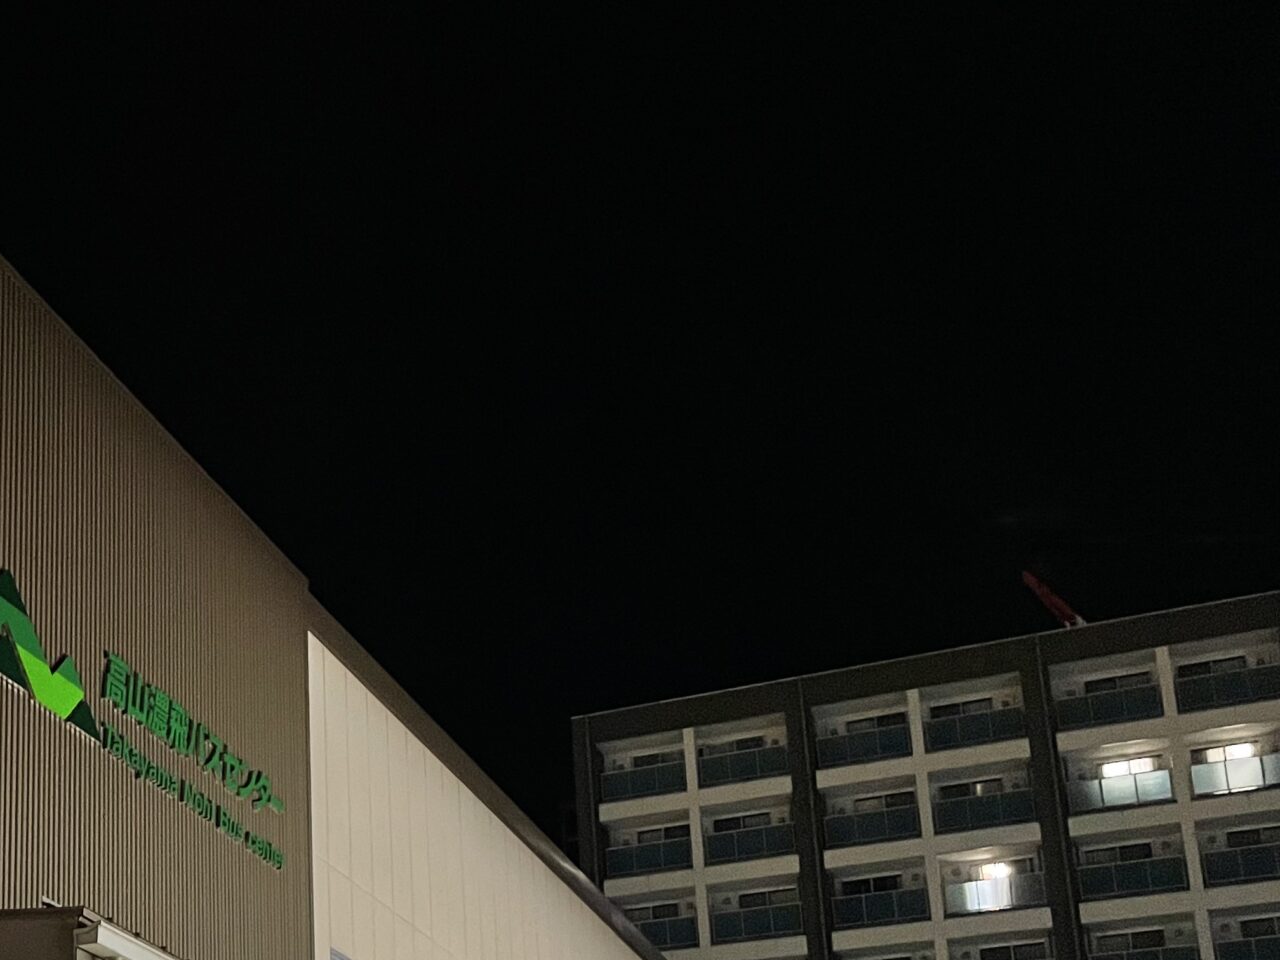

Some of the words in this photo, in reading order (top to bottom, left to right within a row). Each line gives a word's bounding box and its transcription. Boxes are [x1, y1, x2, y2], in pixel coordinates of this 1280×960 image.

[104, 652, 285, 813] 高山濃飛バスセンター
